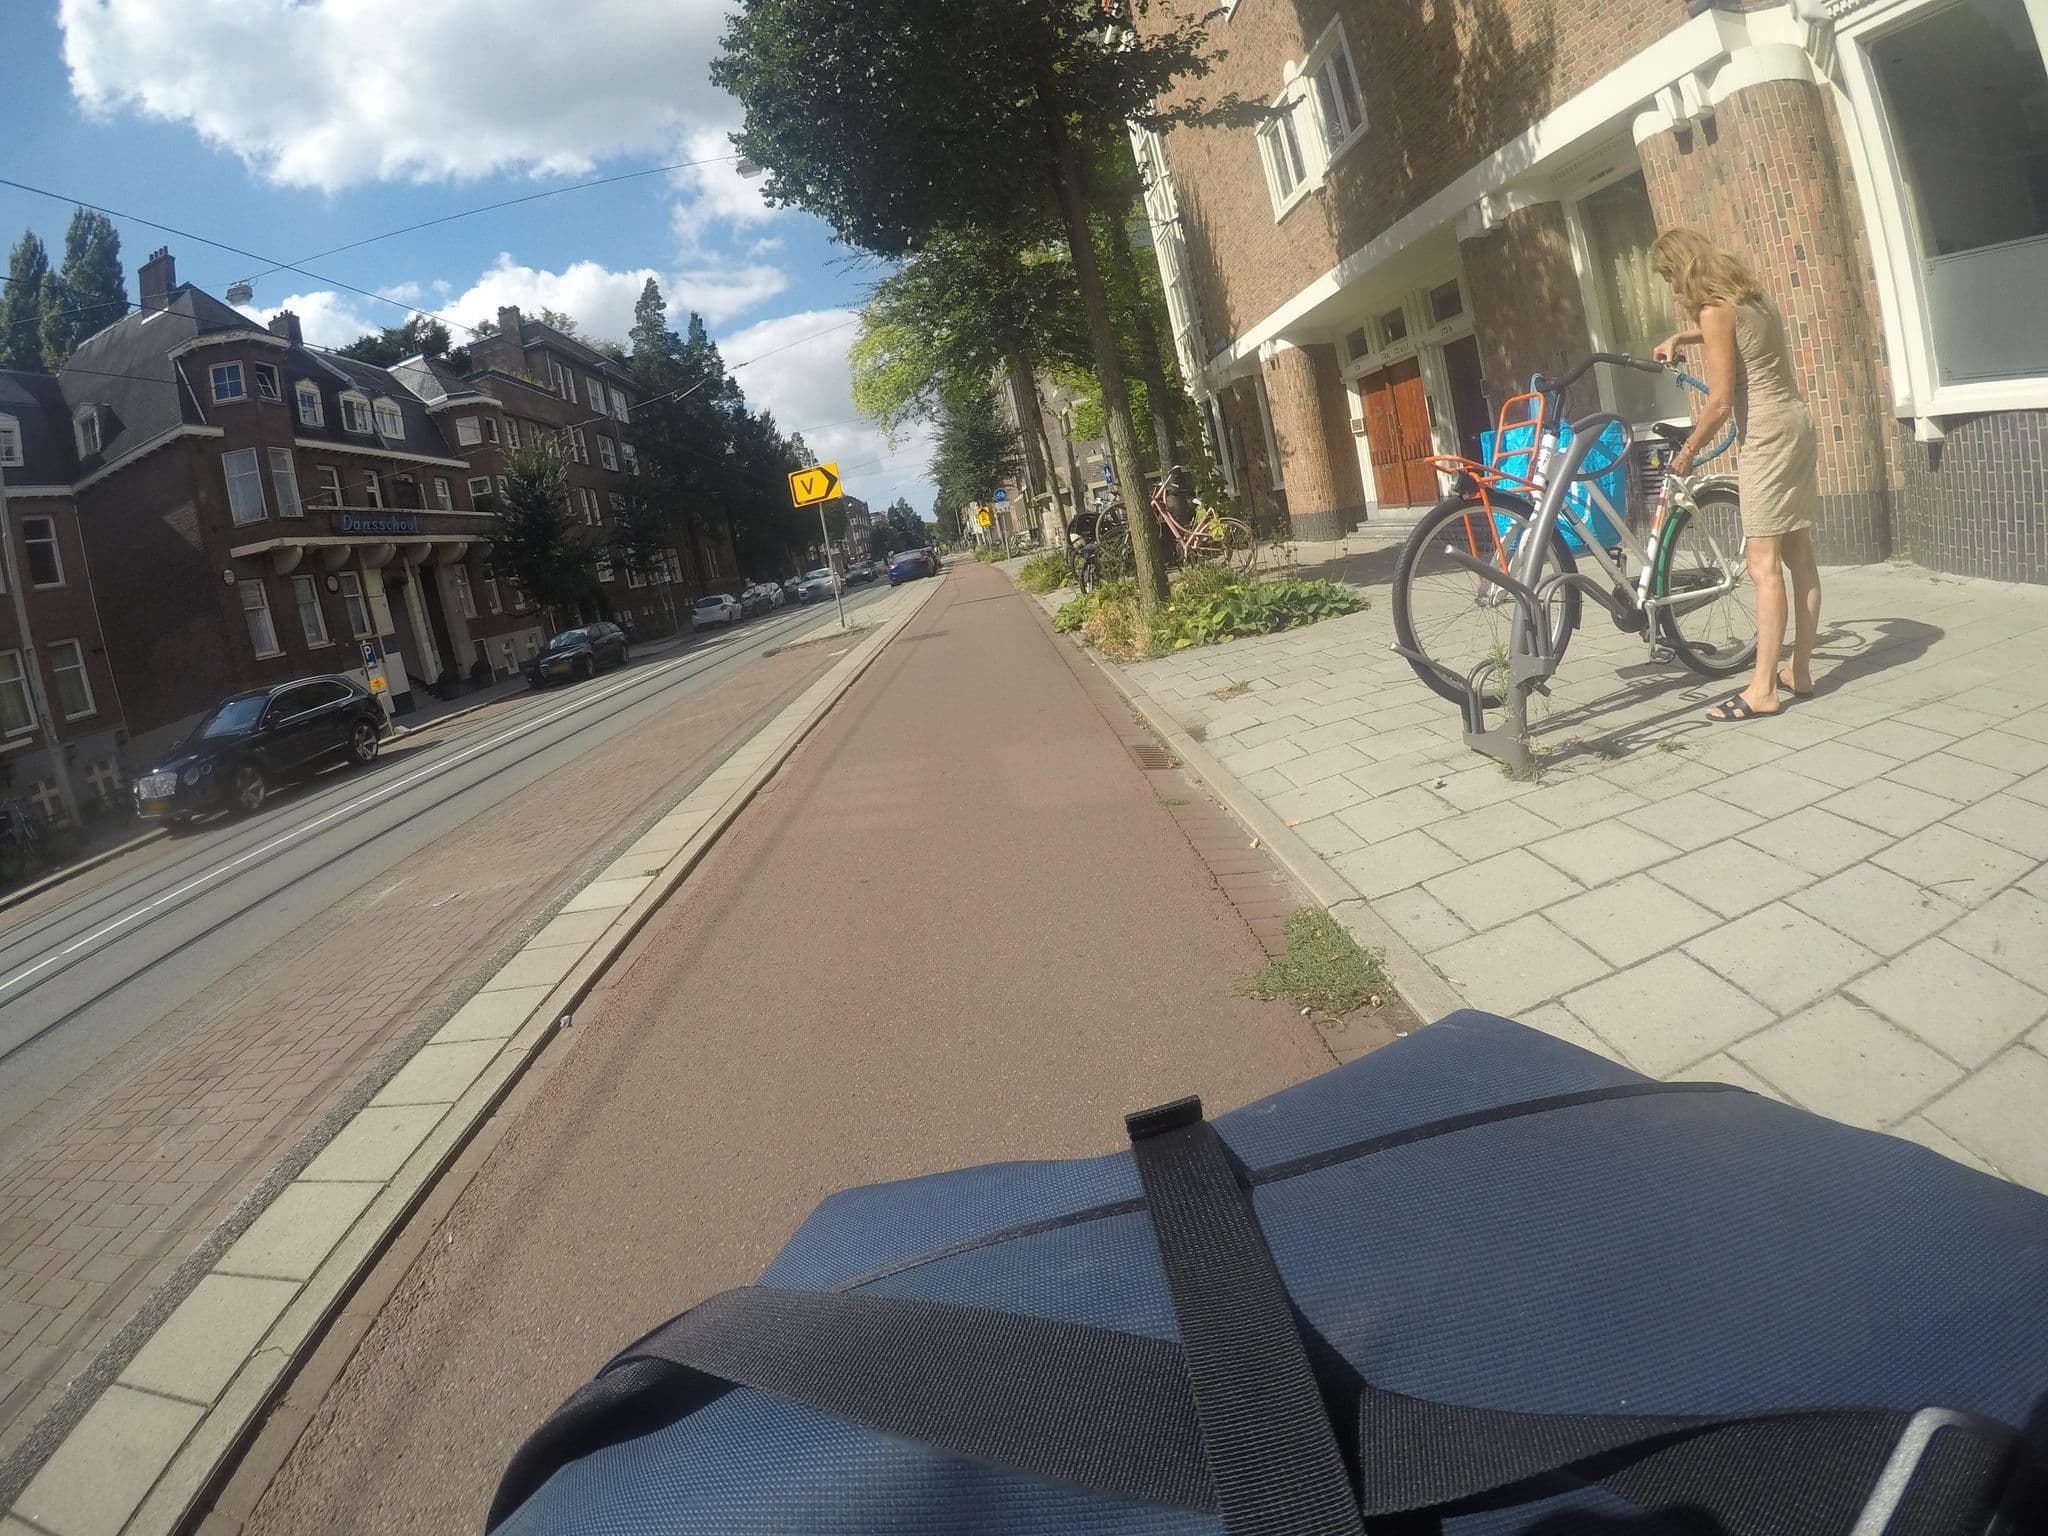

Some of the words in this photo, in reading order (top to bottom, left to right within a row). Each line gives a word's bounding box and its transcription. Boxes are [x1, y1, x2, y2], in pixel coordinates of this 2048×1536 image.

[800, 477, 814, 495] V
[343, 514, 417, 531] Dansschool
[364, 645, 372, 659] P
